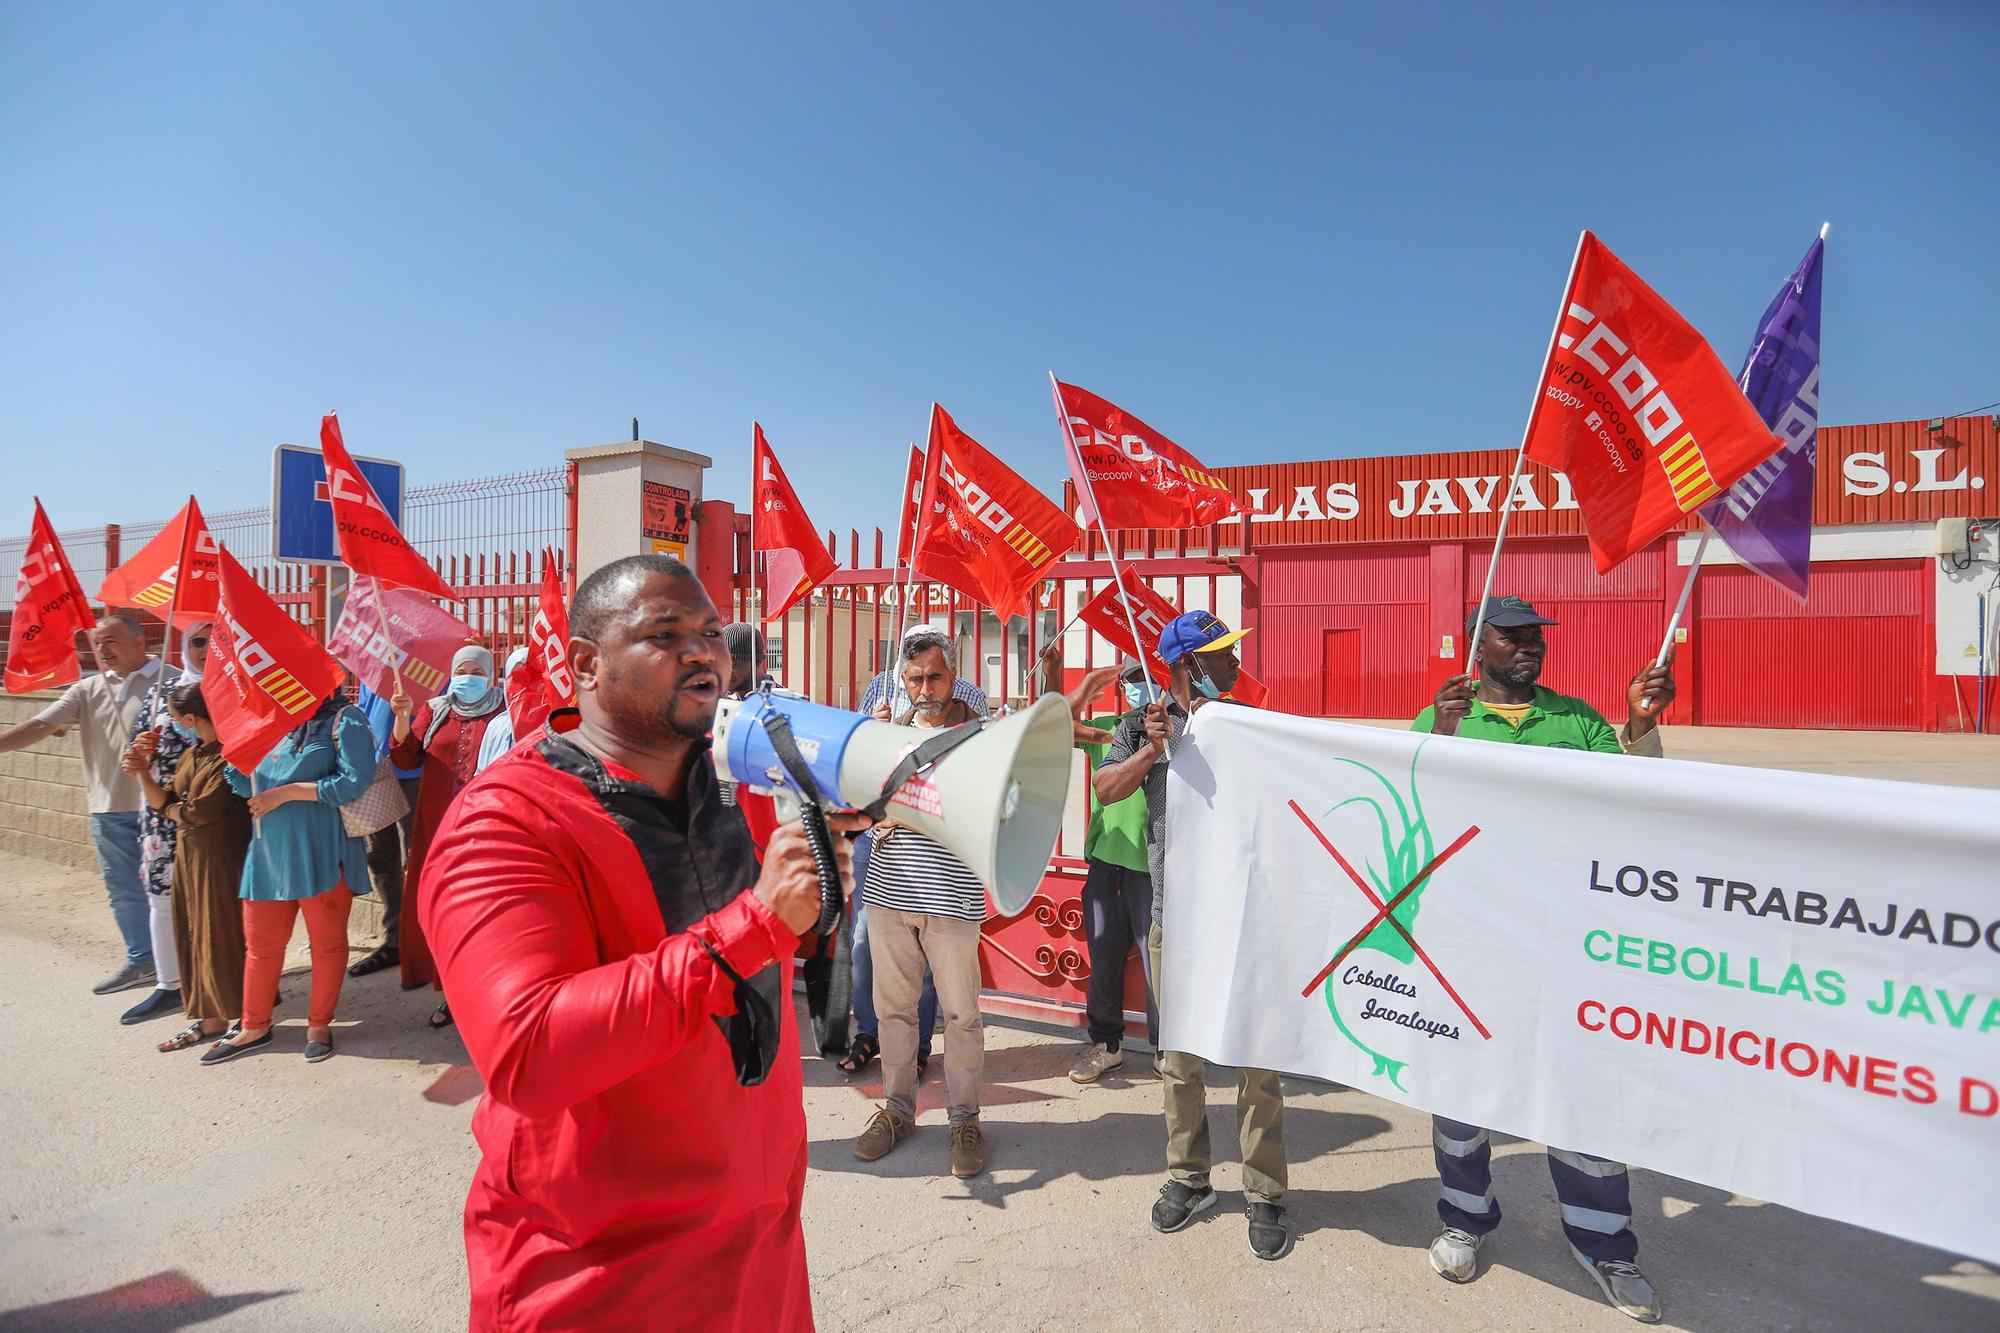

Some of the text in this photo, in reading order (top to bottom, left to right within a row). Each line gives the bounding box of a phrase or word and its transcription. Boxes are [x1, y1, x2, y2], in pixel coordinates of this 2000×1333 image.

[1599, 430, 1628, 474] ccoopv
[1843, 449, 1985, 496] S.L.
[645, 482, 688, 499] CONTROLADA
[1590, 861, 1679, 902] LOS
[1343, 965, 1417, 998] Cebollas
[1584, 929, 1846, 1006] CEBOLLAS
[1361, 998, 1460, 1040] Javaloyes
[1577, 1000, 1938, 1104] CONDICIONES
